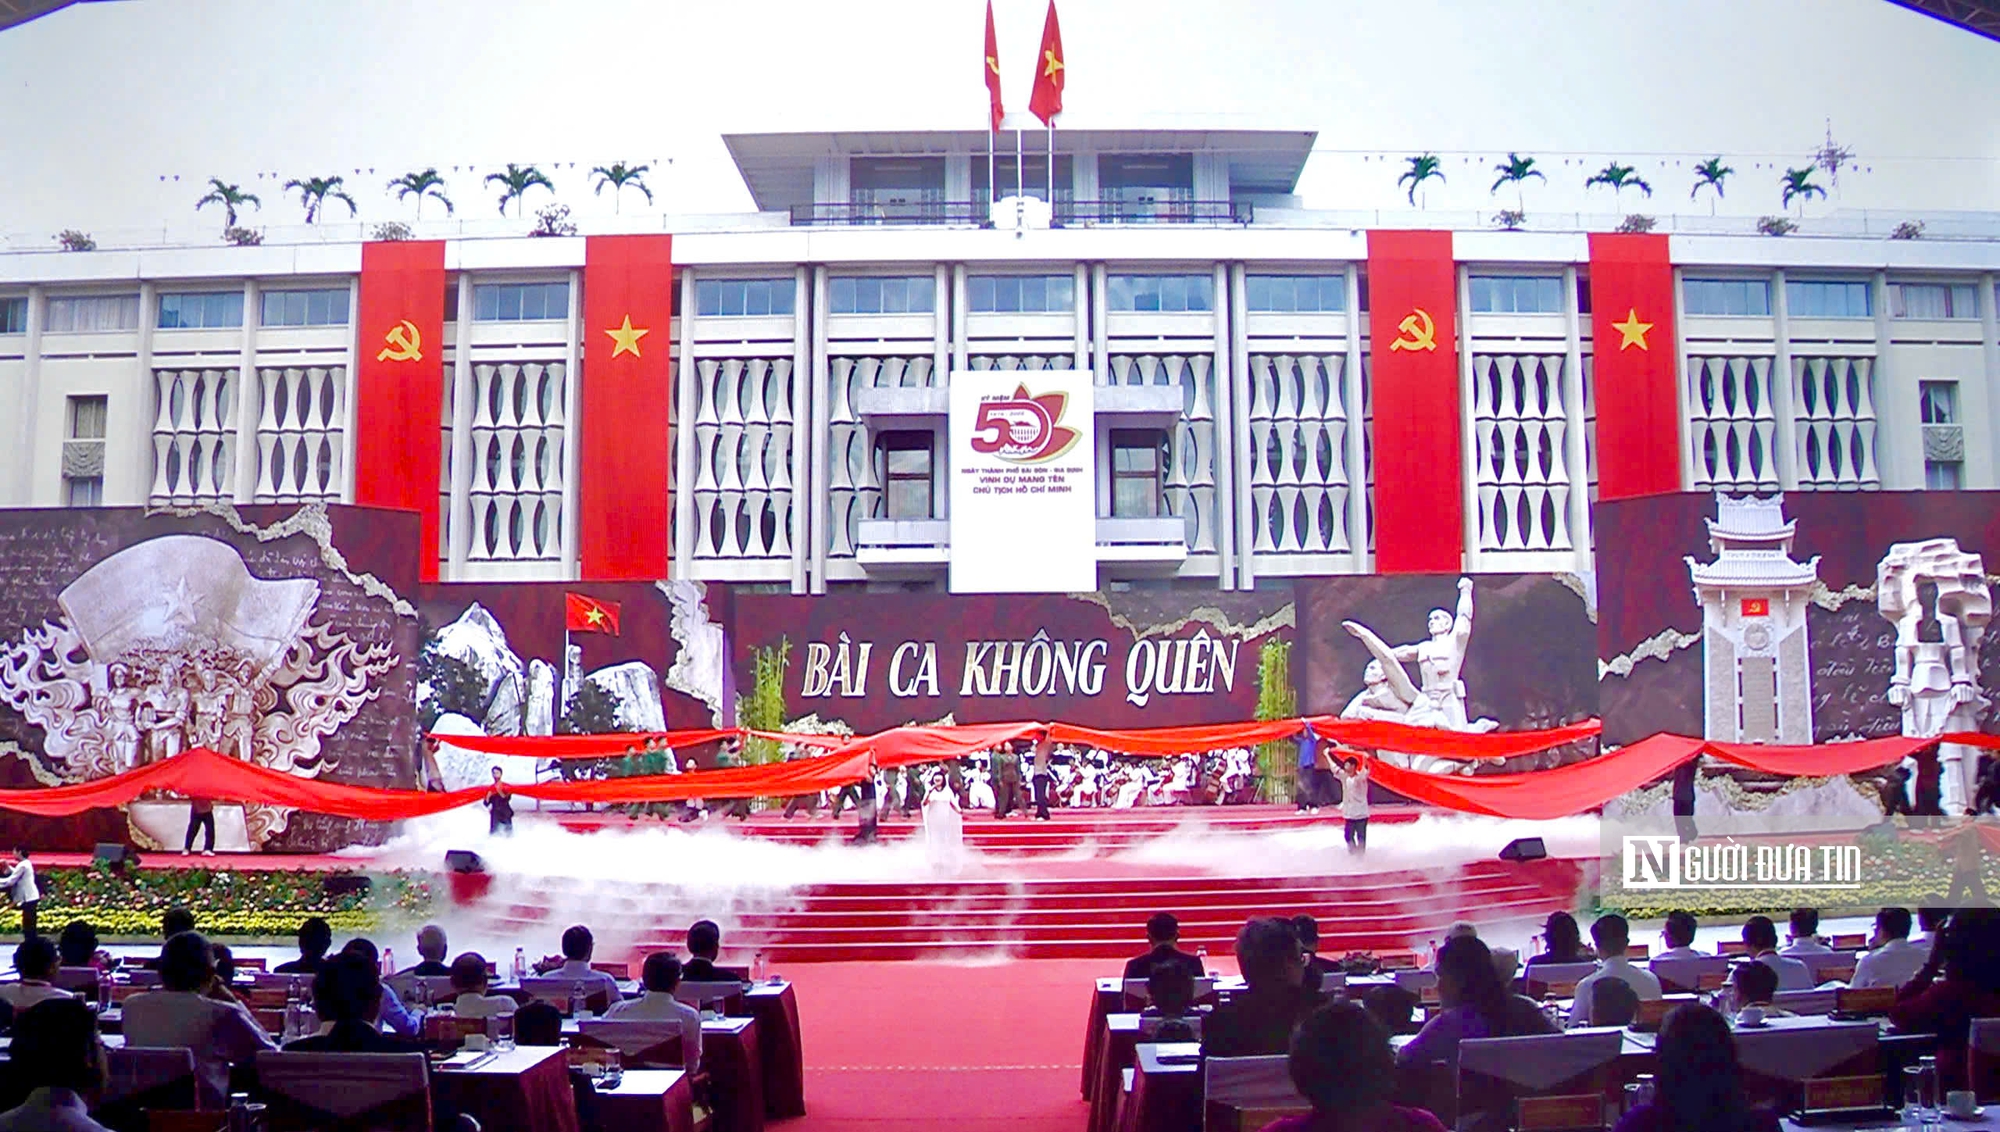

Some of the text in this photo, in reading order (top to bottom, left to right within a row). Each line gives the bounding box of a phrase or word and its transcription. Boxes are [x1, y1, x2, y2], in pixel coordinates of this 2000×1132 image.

[1003, 476, 1016, 484] DỰ
[1048, 474, 1065, 482] TÊN
[972, 485, 991, 494] CHỦ
[994, 486, 1013, 495] TỊCH
[1016, 484, 1028, 494] HỒ
[1030, 485, 1046, 494] CHÍ
[801, 627, 1240, 707] BÀI CA KHÔNG QUÊN
